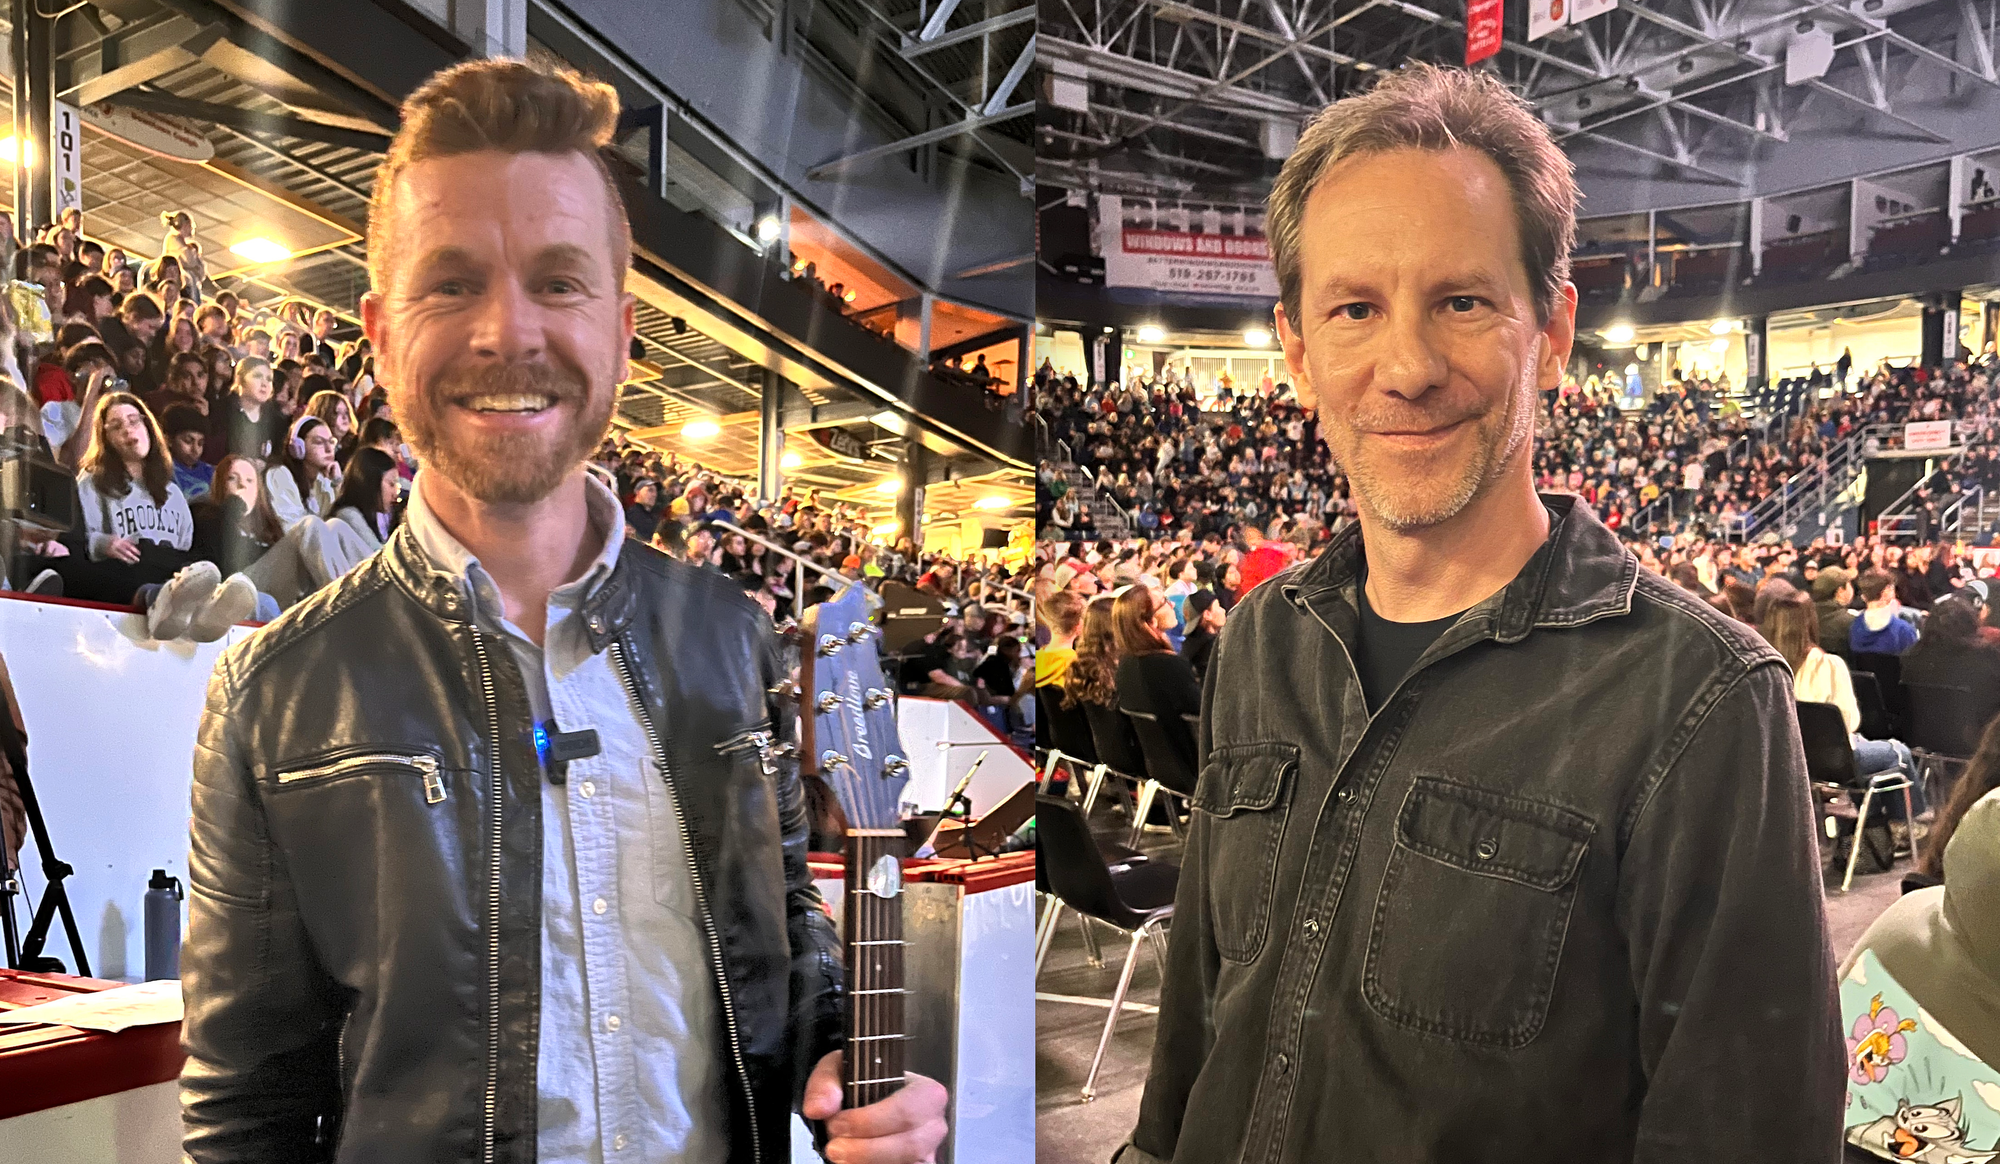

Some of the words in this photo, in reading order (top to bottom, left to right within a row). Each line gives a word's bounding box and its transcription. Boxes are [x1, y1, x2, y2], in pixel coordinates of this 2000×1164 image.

[60, 111, 73, 172] 101
[1125, 232, 1194, 253] WINDOWS
[1195, 235, 1223, 254] AND
